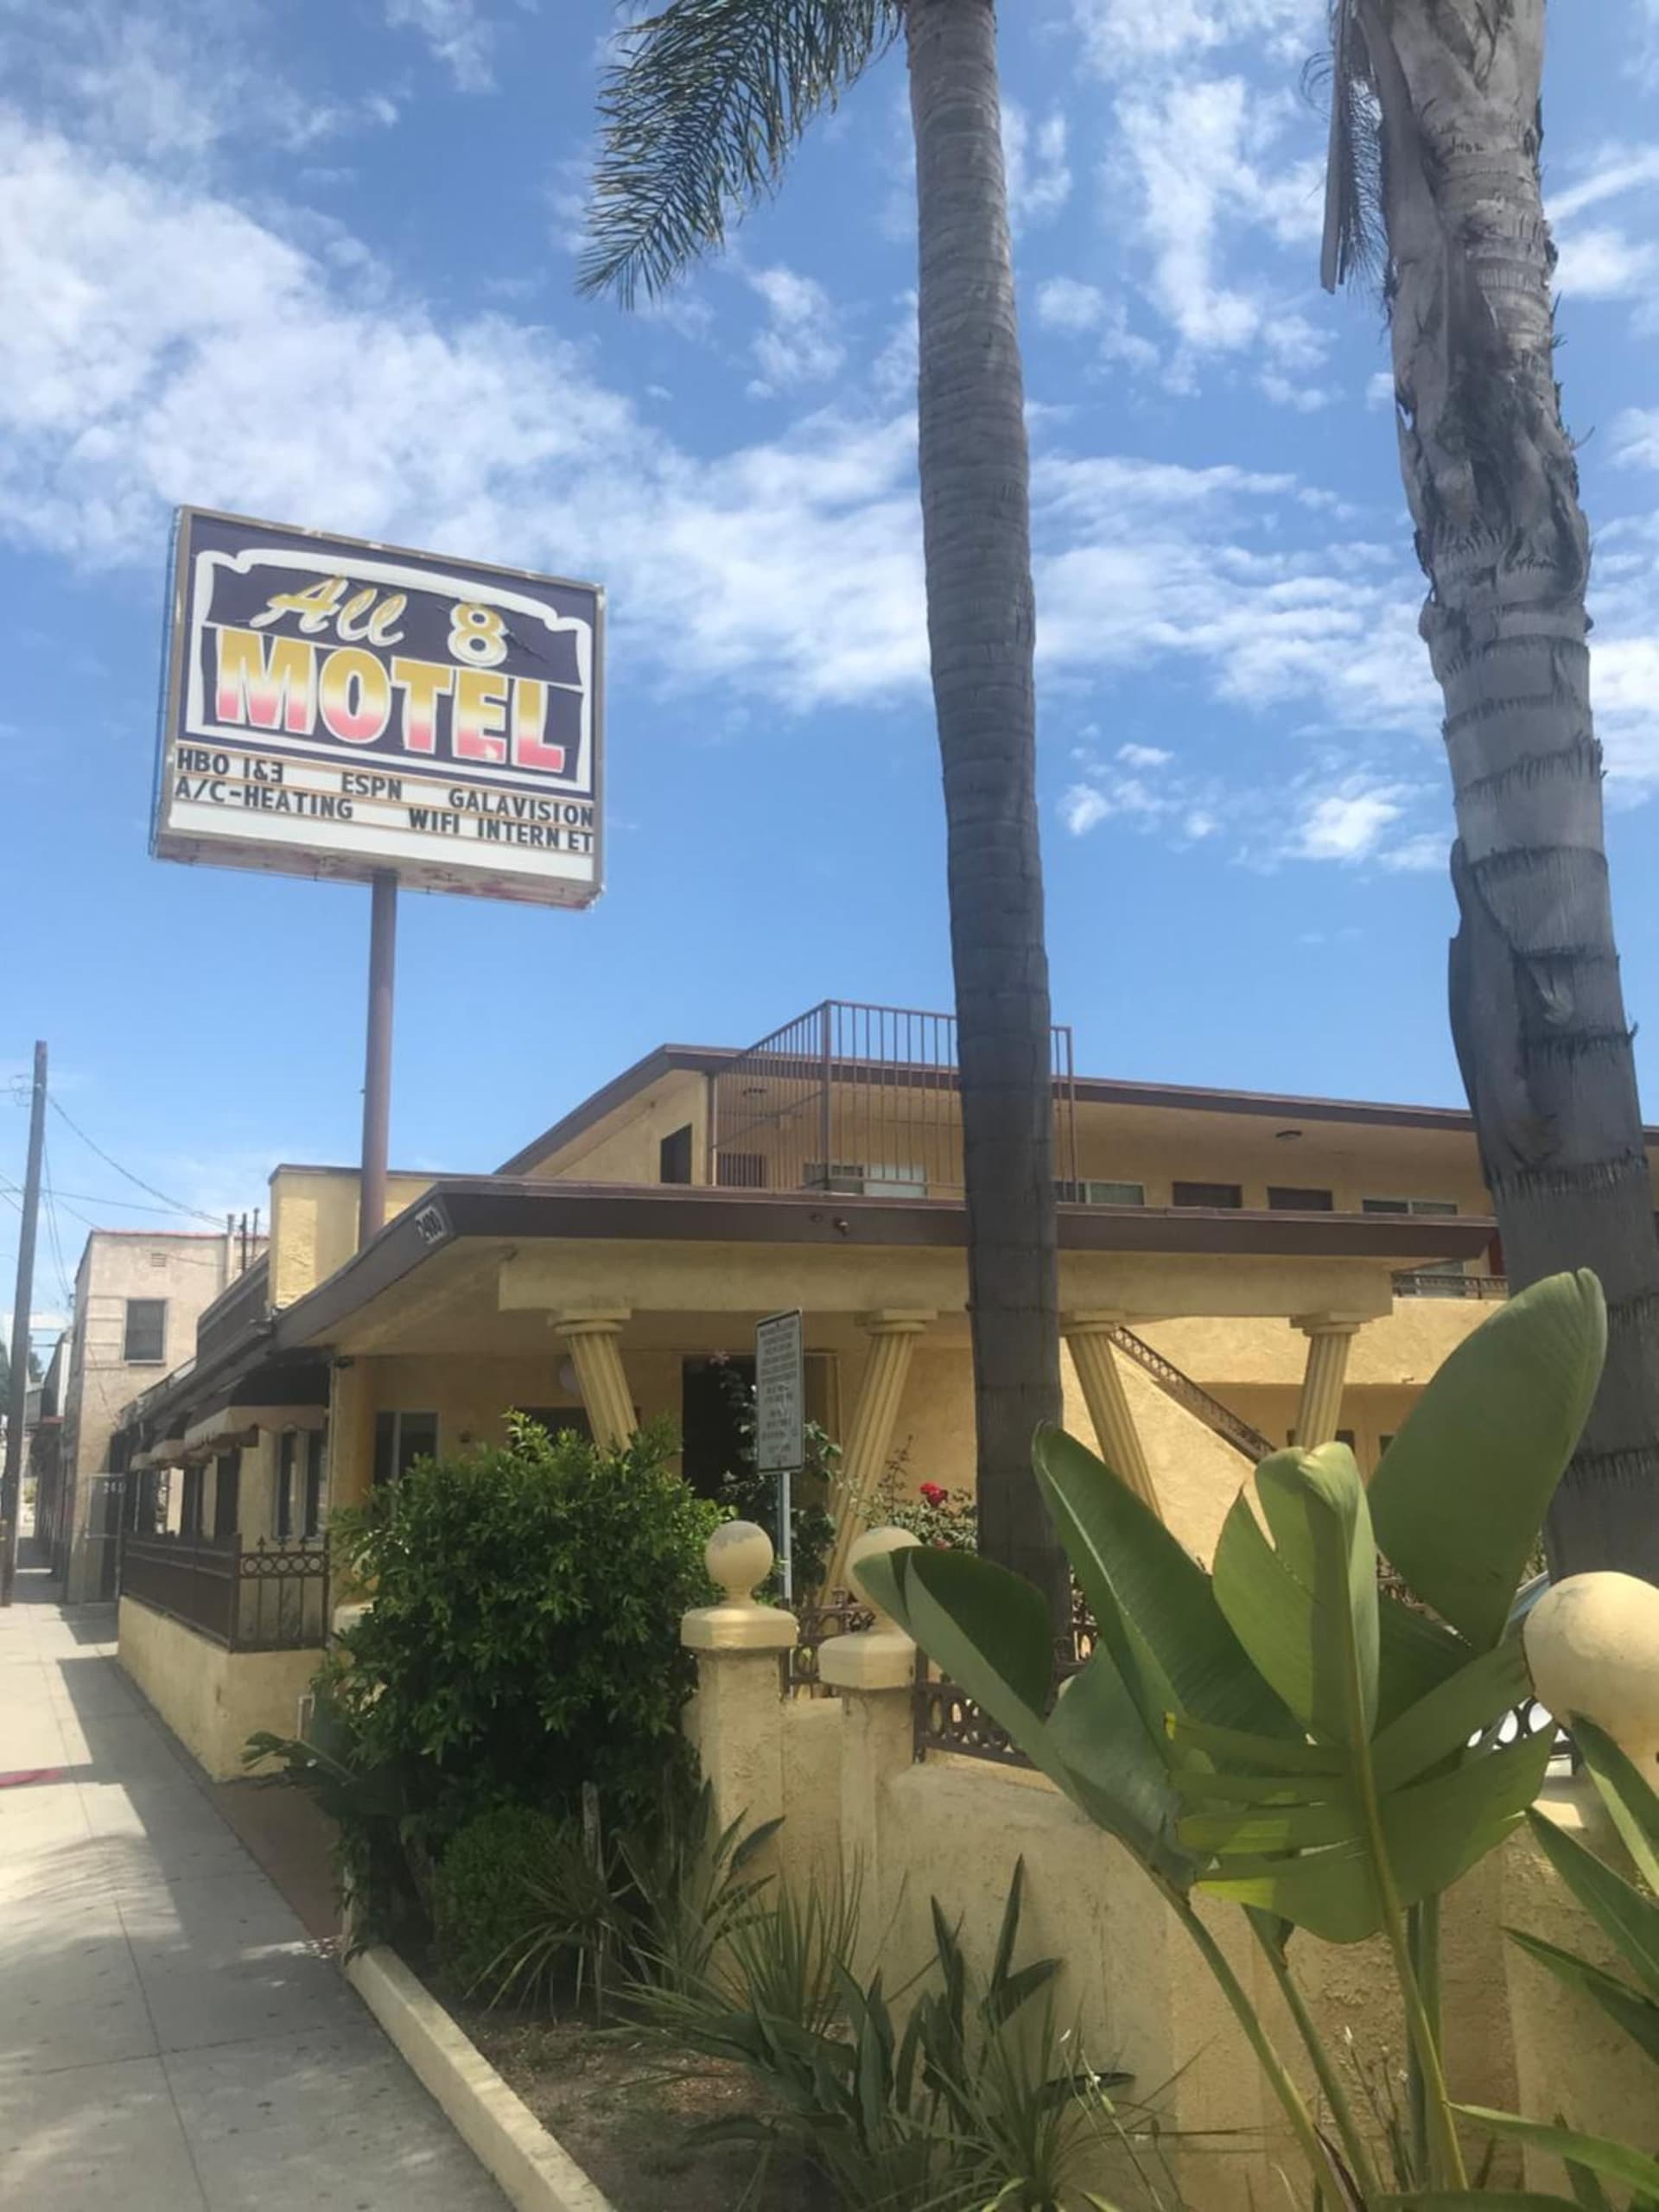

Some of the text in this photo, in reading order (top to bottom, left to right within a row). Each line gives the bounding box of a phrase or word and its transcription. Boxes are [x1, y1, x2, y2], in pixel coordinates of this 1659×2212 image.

[251, 574, 508, 666] All 8
[217, 626, 565, 772] MOTEL
[176, 748, 230, 776] HBO
[341, 772, 403, 801] ESPN
[448, 787, 594, 828] GALAVISION
[409, 807, 461, 835] WIFI
